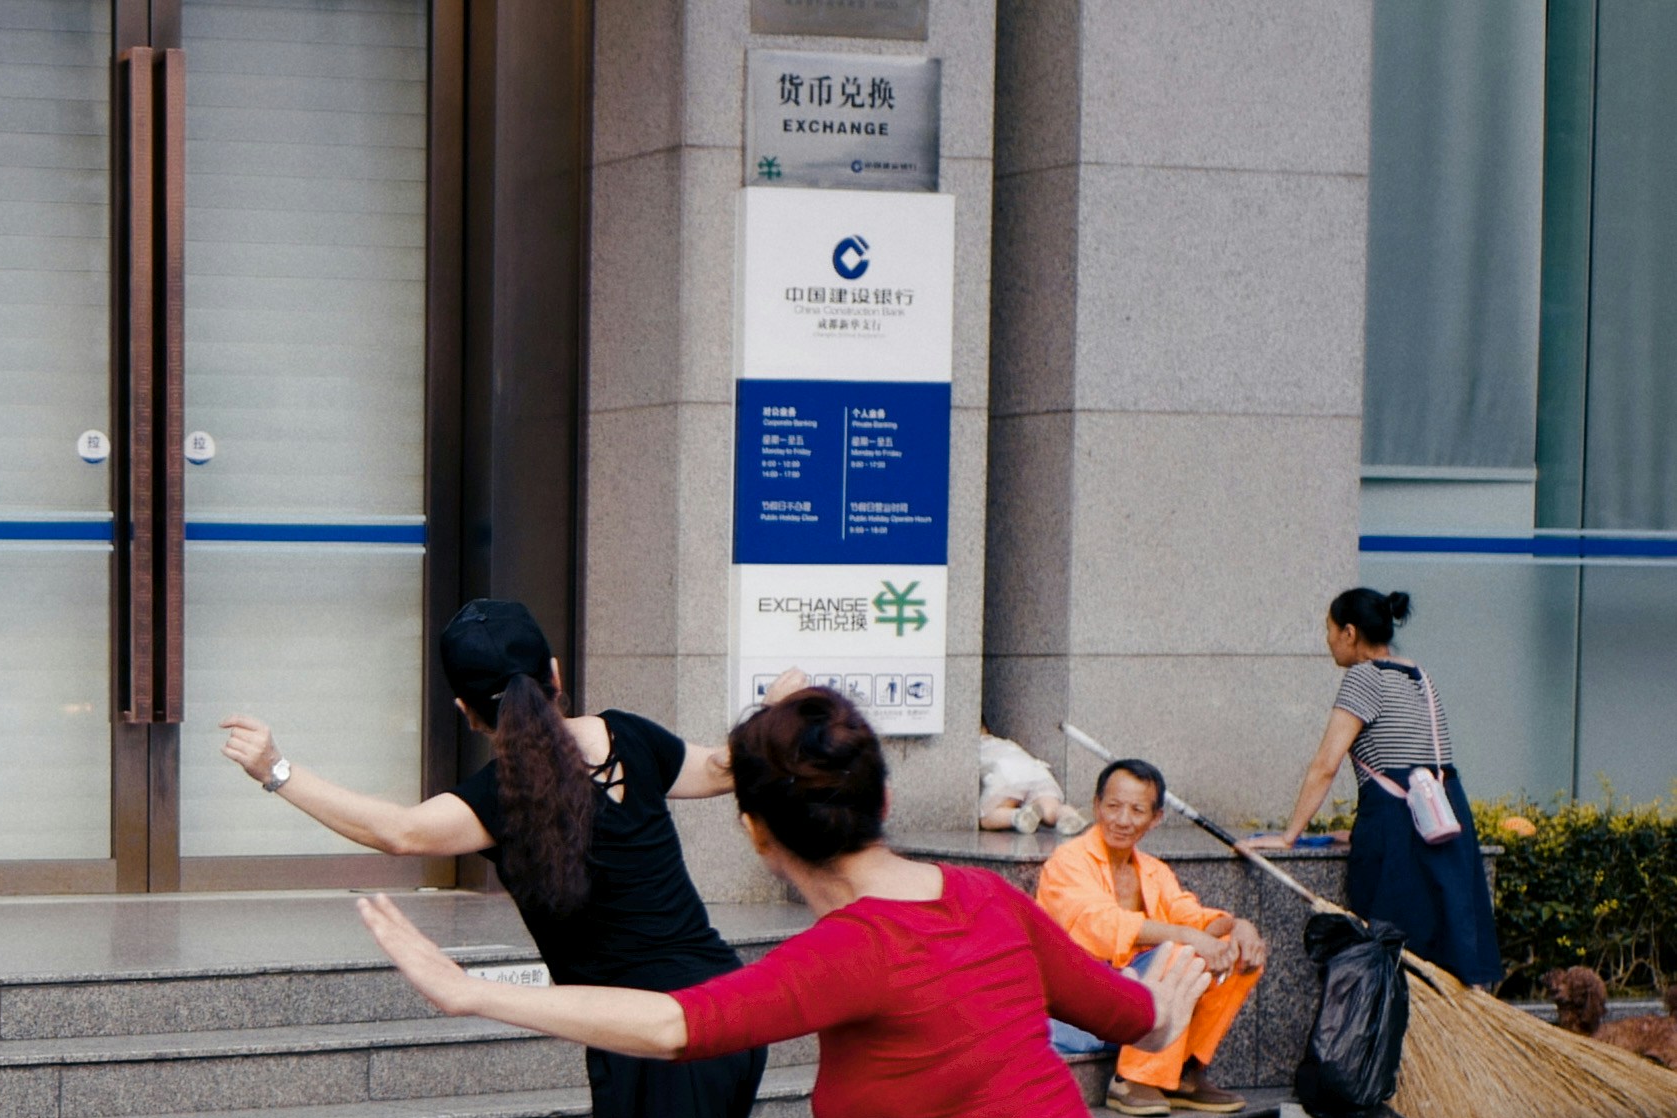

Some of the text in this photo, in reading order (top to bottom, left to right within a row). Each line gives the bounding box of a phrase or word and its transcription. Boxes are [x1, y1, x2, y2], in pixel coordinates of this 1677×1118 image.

[779, 73, 895, 110] 货币兑换
[783, 119, 889, 136] EXCHANGE
[785, 286, 915, 306] 中国建设银行
[794, 305, 821, 315] China
[882, 307, 906, 317] Bank
[758, 597, 868, 613] EXCHANGE
[799, 613, 868, 632] 货币兑换
